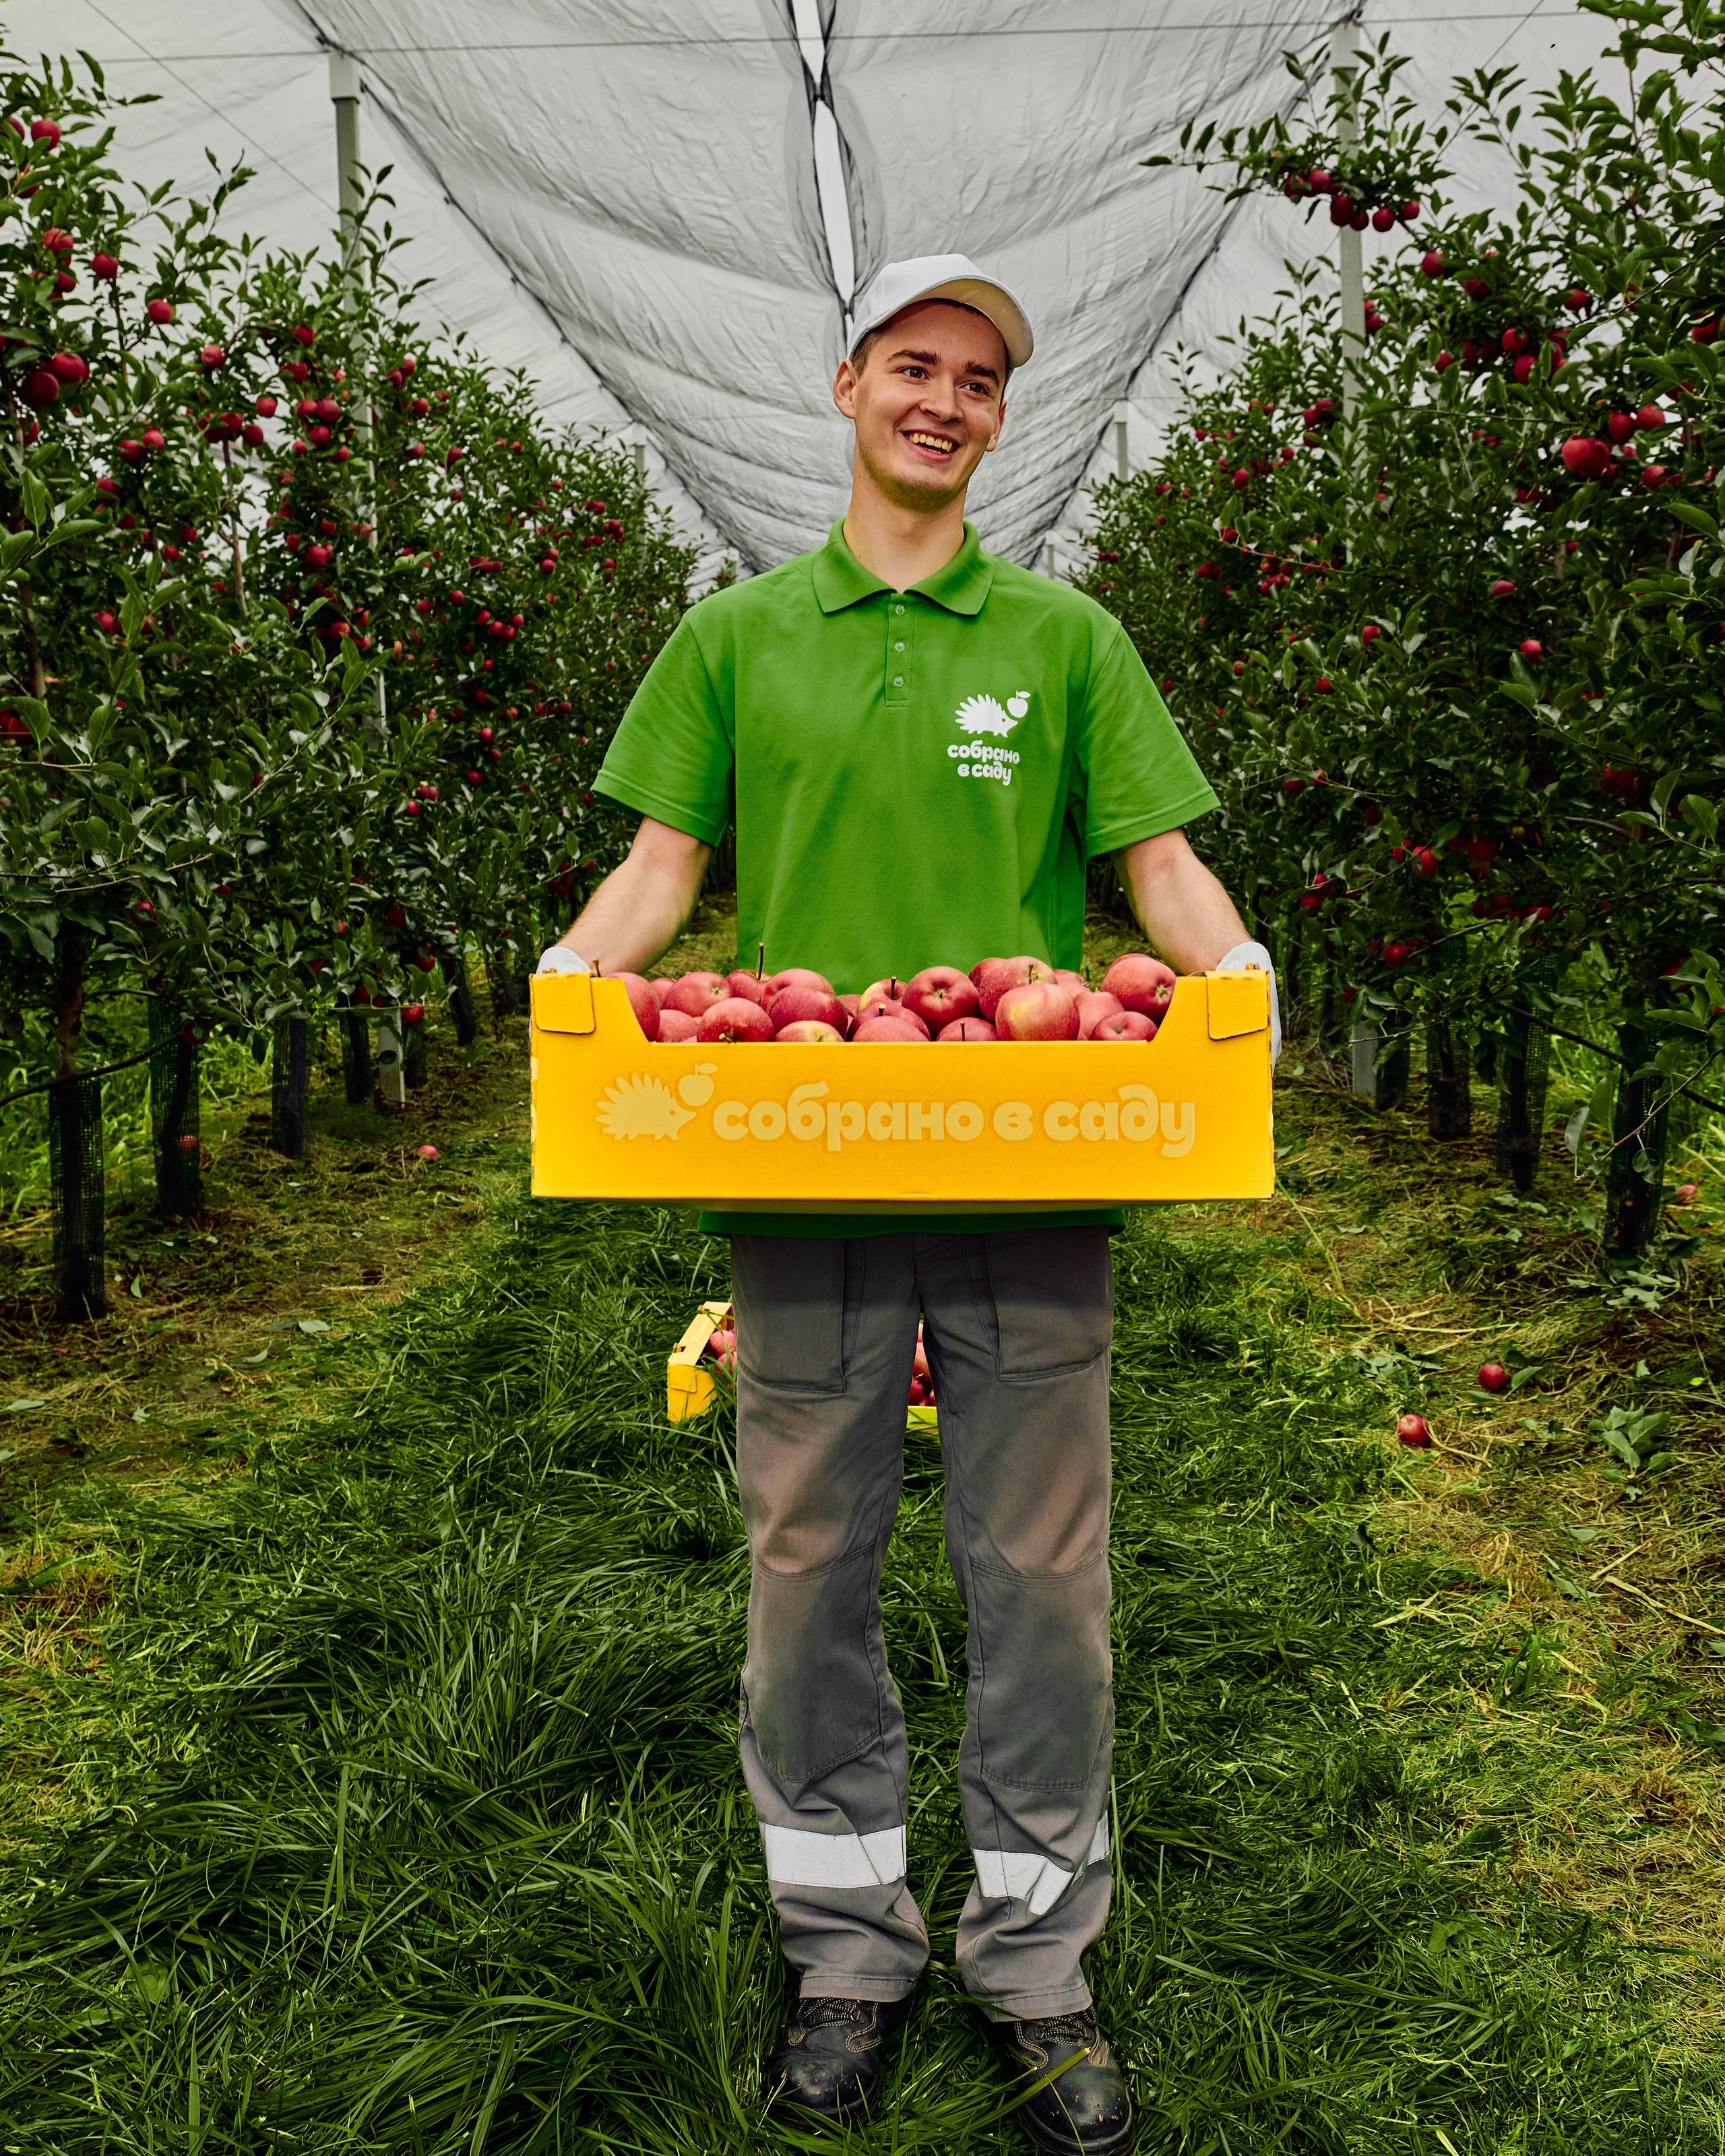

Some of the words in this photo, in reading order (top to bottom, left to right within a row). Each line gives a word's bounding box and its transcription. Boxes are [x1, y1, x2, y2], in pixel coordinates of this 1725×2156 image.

[947, 739, 1020, 765] собрано
[957, 763, 970, 777] в
[971, 761, 1012, 786] саду
[712, 1080, 984, 1152] собрано
[993, 1100, 1034, 1141] в
[1044, 1083, 1195, 1158] саду
